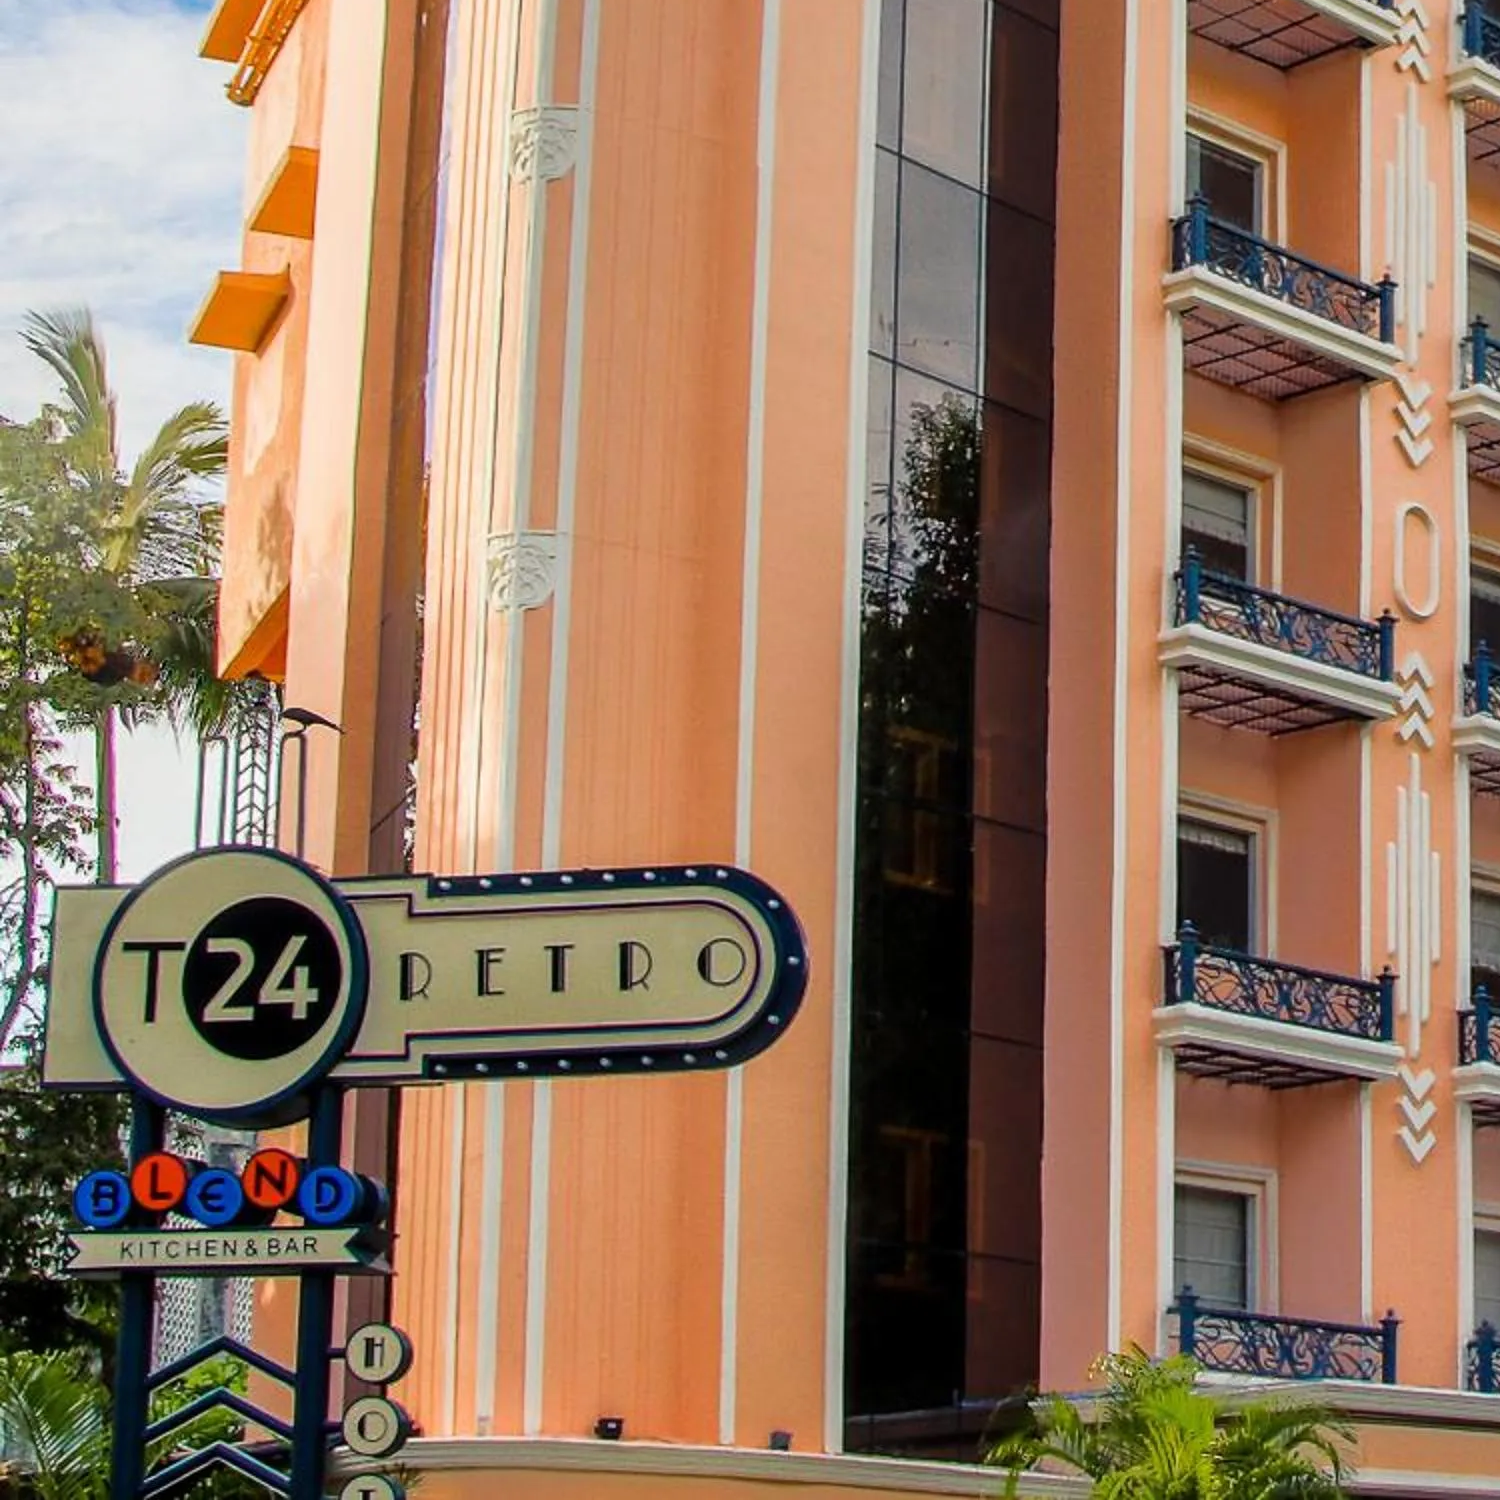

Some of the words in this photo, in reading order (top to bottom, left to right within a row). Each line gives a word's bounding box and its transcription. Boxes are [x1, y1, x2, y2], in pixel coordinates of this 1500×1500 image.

[122, 935, 319, 1023] T24
[400, 938, 746, 1000] RETRO
[92, 1160, 343, 1216] BLEND
[120, 1239, 237, 1259] KITCHEN
[268, 1236, 318, 1253] BAR
